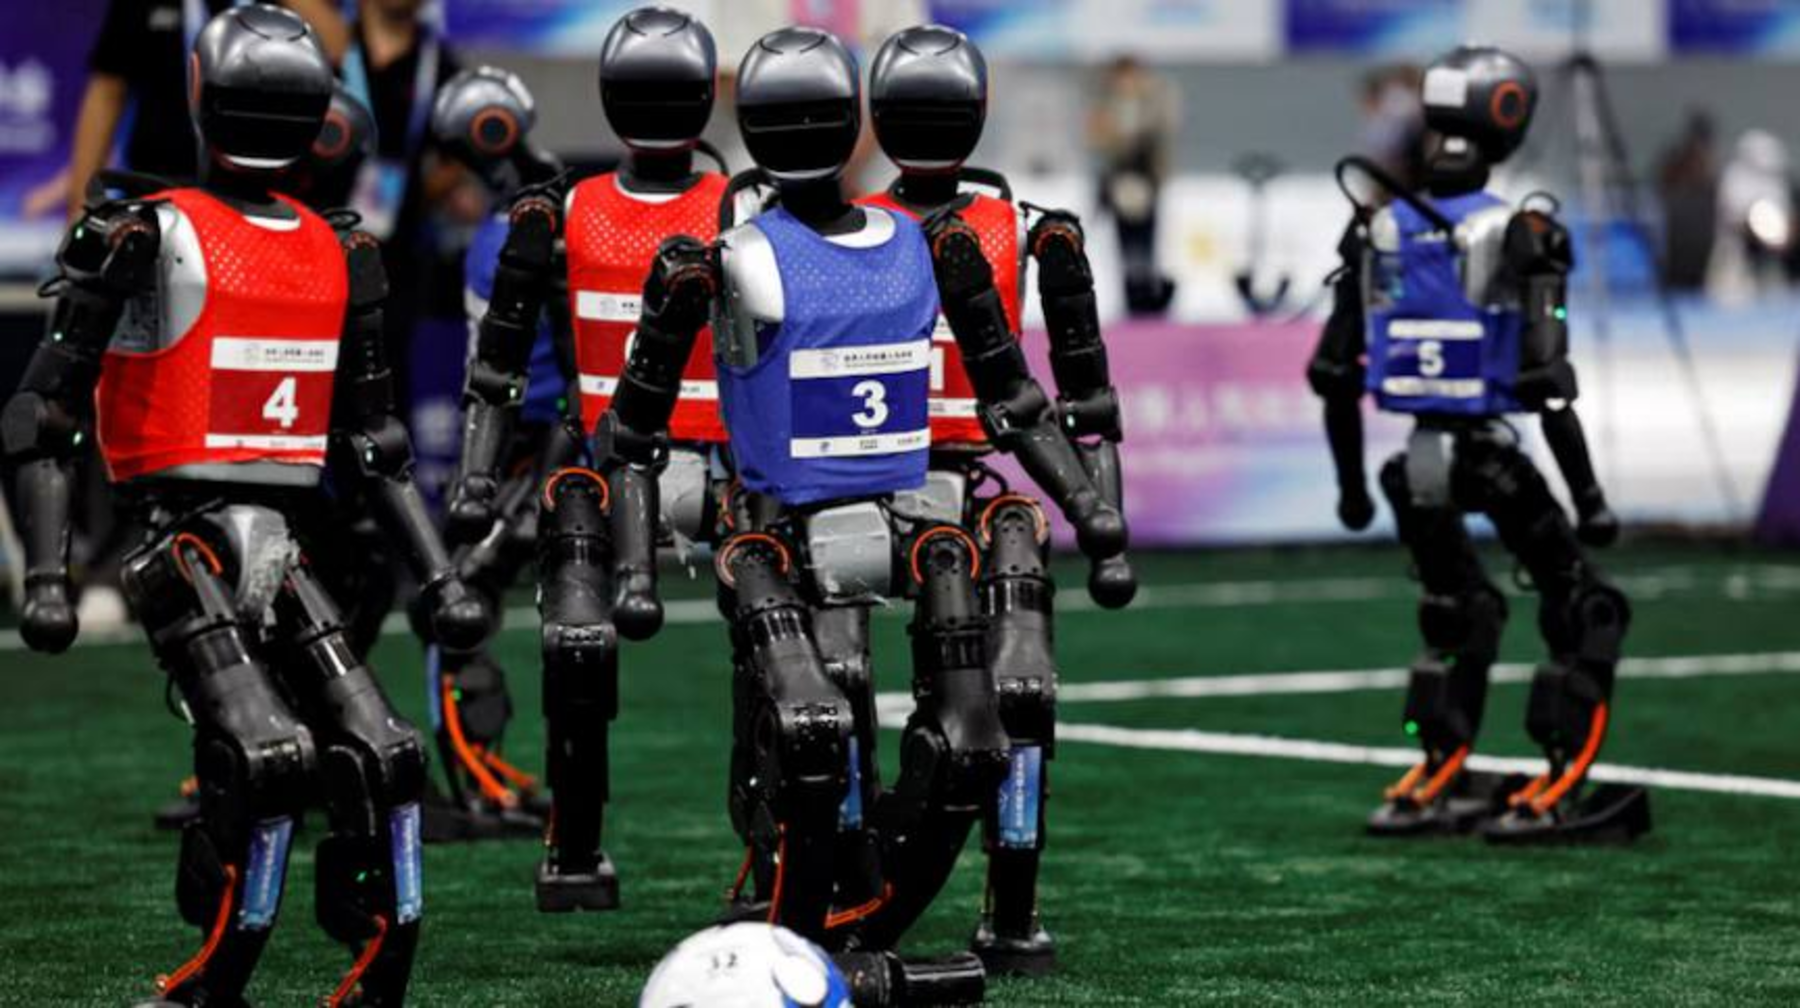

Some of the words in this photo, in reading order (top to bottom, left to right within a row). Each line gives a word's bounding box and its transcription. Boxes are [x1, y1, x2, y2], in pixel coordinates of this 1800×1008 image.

[1418, 340, 1444, 377] 5
[262, 377, 298, 428] 4
[852, 380, 888, 428] 3
